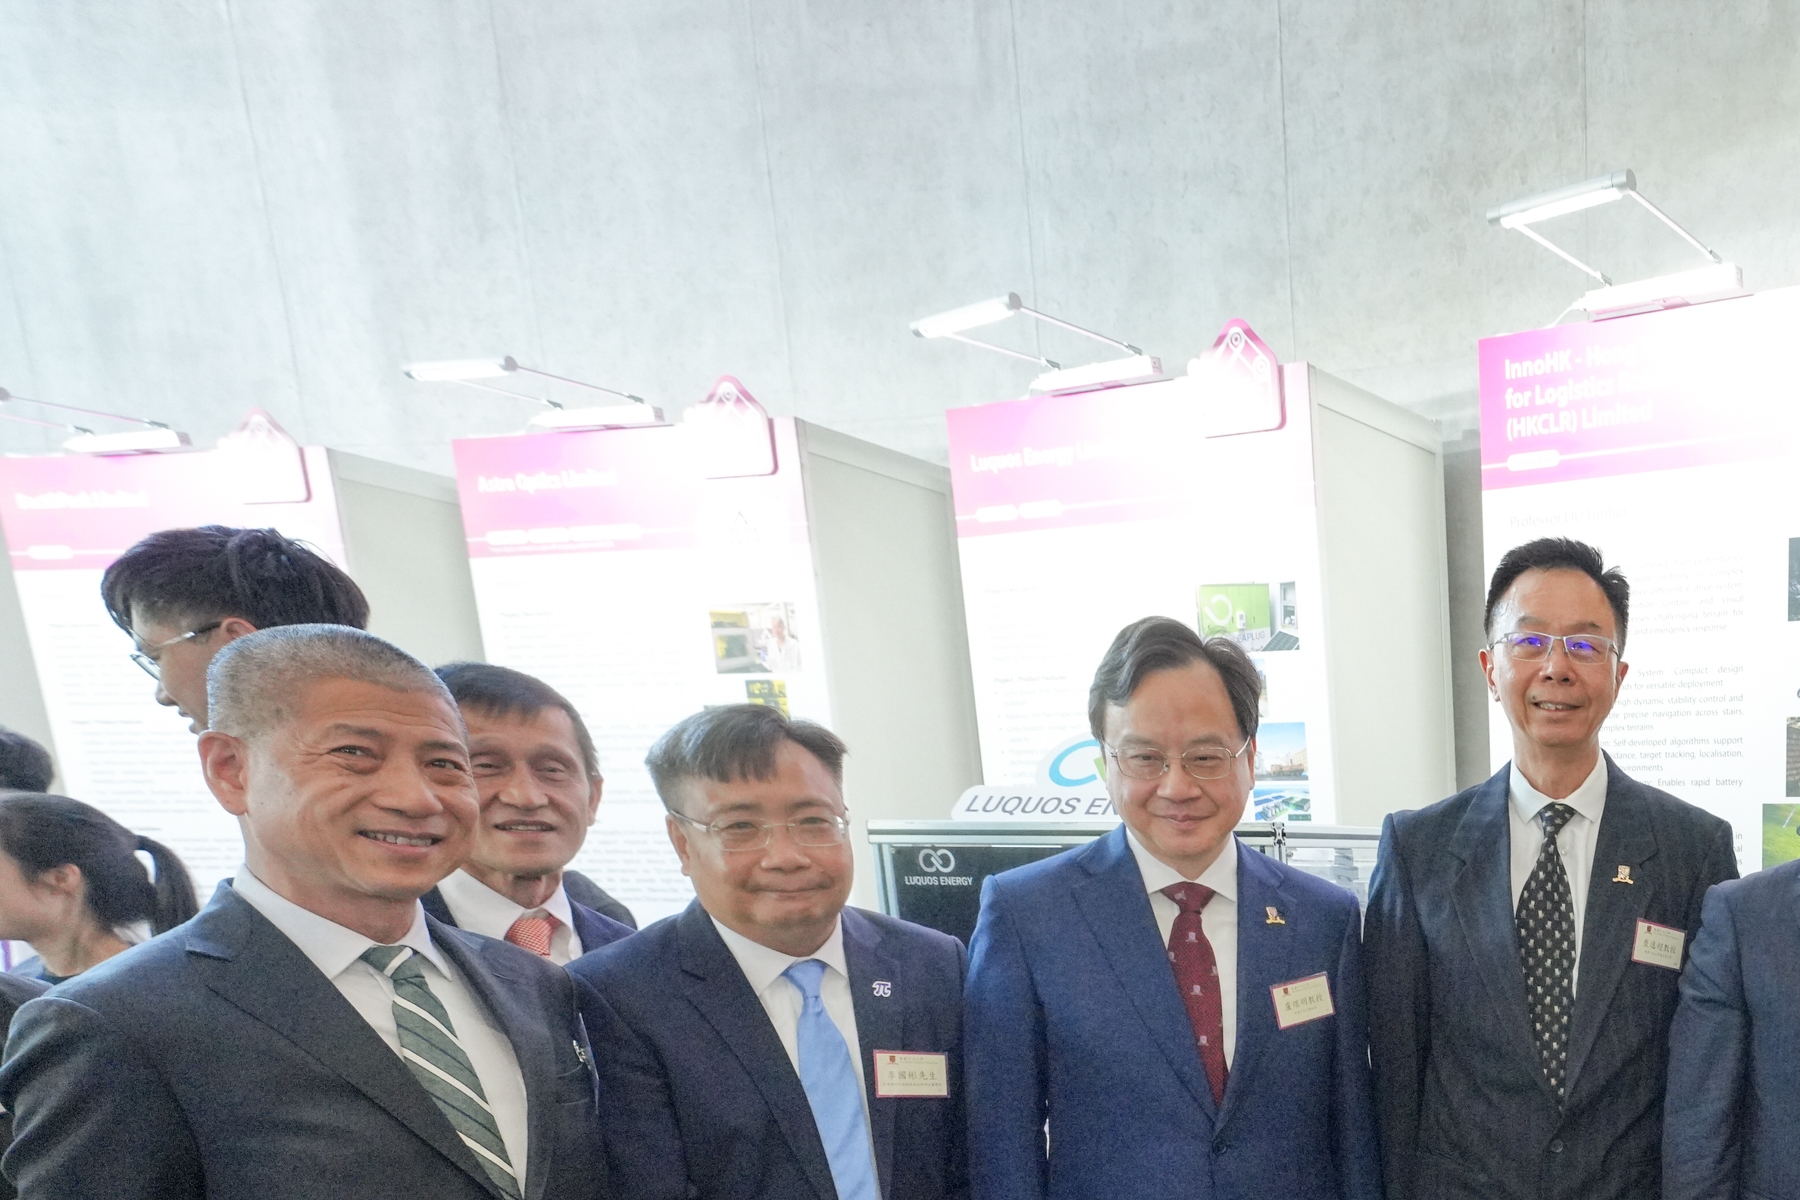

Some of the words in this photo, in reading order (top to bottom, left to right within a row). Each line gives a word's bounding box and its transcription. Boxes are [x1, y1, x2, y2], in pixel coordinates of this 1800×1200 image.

[1505, 349, 1572, 380] InnoHK
[1586, 345, 1638, 368] Hong
[1505, 387, 1532, 409] for
[1535, 375, 1615, 408] Logistics
[1506, 409, 1577, 442] (HKCLR)
[1581, 399, 1653, 429] Limited
[1510, 512, 1561, 528] Professor
[1649, 624, 1692, 636] emergency
[1637, 669, 1666, 679] System:
[1674, 666, 1708, 678] Compact
[1717, 665, 1744, 676] design
[1634, 682, 1645, 691] for
[1646, 681, 1677, 690] versatile
[1678, 679, 1724, 690] deployment
[1667, 696, 1697, 706] stability
[1699, 694, 1727, 704] control
[1728, 693, 1744, 703] and
[1623, 711, 1649, 721] precise
[1652, 709, 1692, 720] navigation
[1695, 709, 1719, 718] across
[1722, 708, 1744, 718] stairs,
[1627, 723, 1654, 732] terrains
[1613, 737, 1667, 748] Self-developed
[1669, 736, 1710, 748] algorithms
[1713, 736, 1744, 747] support
[1639, 751, 1662, 762] target
[1665, 749, 1697, 761] tracking,
[1699, 748, 1744, 759] localisation,
[1657, 778, 1686, 788] Enables
[1690, 777, 1711, 788] rapid
[1715, 778, 1744, 788] battery
[965, 795, 1081, 816] LUQUOS
[904, 876, 939, 886] LUQUOS
[940, 876, 973, 886] ENERGY
